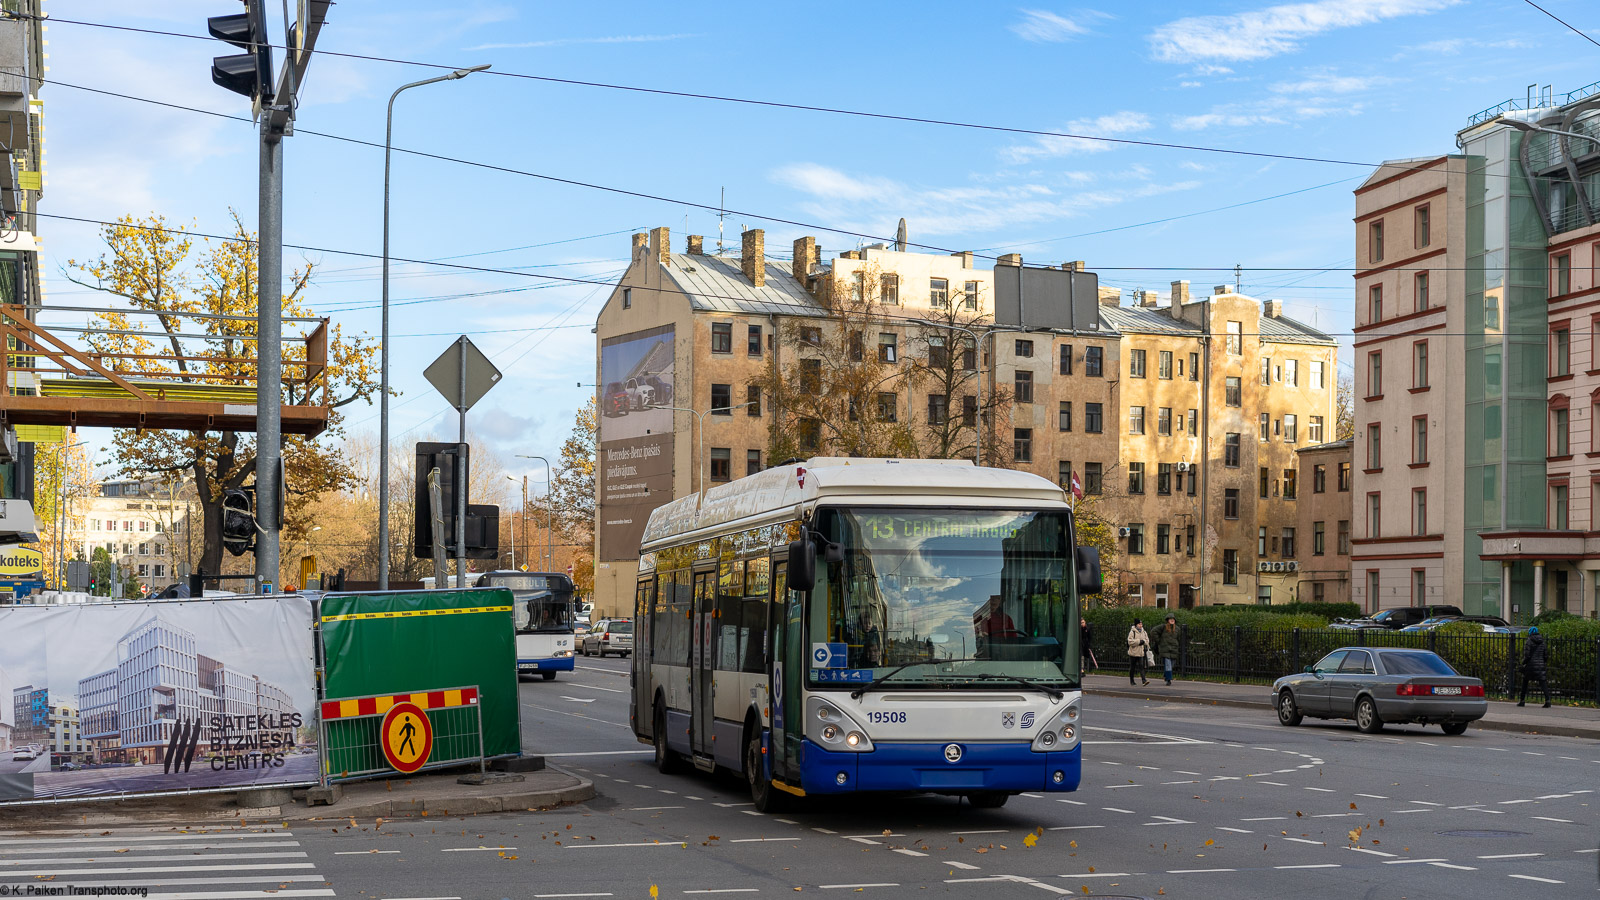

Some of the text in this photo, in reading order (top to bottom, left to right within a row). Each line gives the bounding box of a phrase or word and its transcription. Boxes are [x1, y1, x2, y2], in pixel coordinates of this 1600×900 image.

[607, 445, 642, 461] Mercedes-Benz
[865, 515, 894, 539] 13
[517, 579, 551, 588] SKULTE
[210, 712, 303, 732] SATEKLES
[867, 711, 907, 723] 19508
[210, 732, 296, 752] BIZNESA
[210, 752, 285, 771] CENTRS
